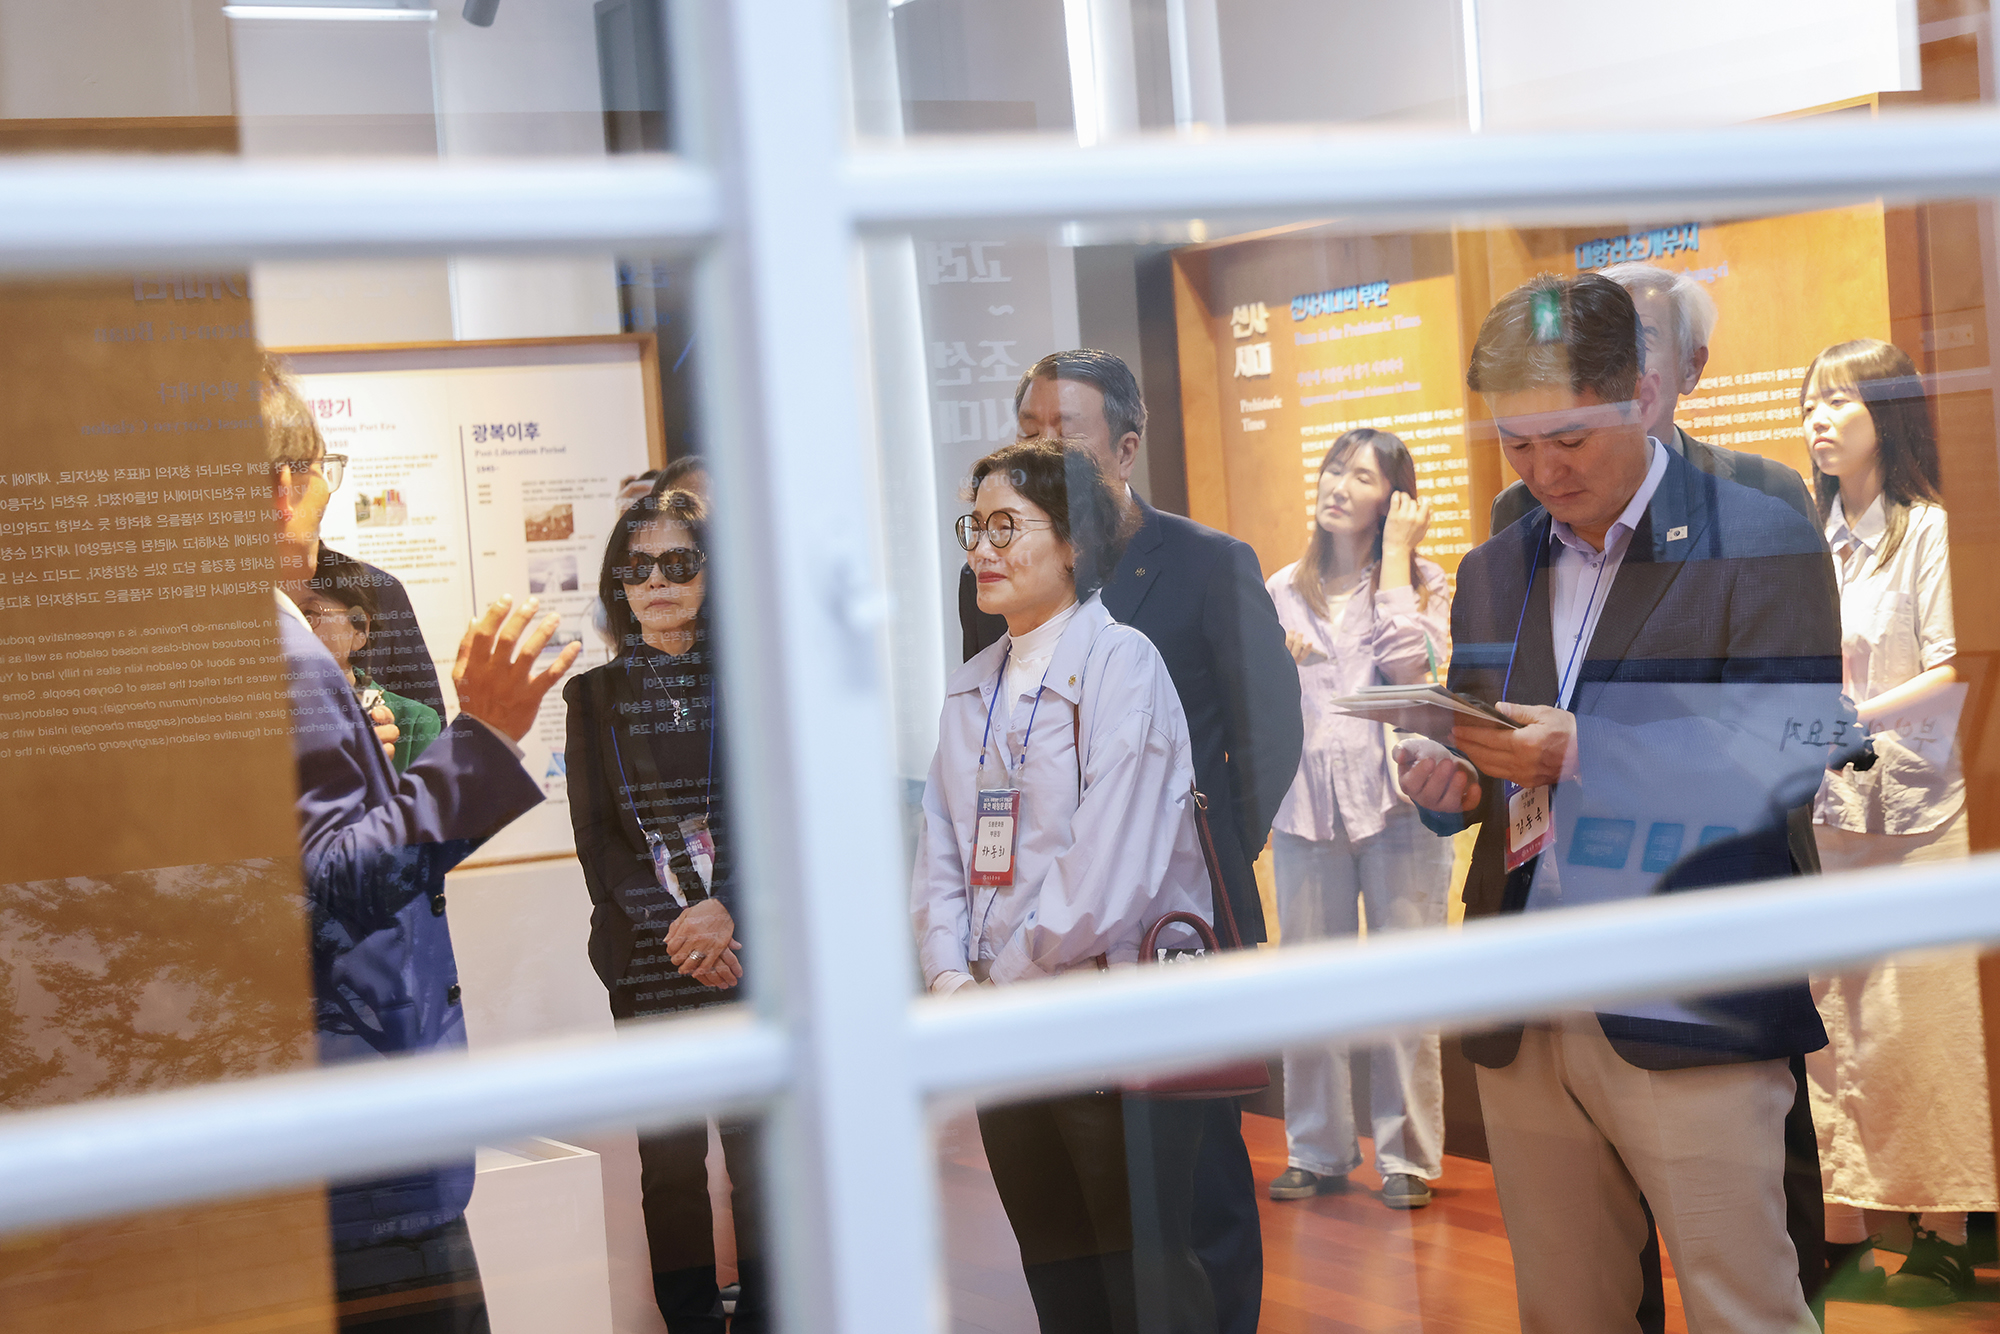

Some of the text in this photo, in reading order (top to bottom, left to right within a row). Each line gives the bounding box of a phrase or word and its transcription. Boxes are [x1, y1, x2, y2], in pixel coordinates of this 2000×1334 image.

[1344, 318, 1392, 338] Prehistoric
[1393, 314, 1422, 330] Times
[1240, 395, 1282, 413] Prehistoric
[472, 422, 540, 443] 광복이후
[1242, 418, 1267, 432] Times
